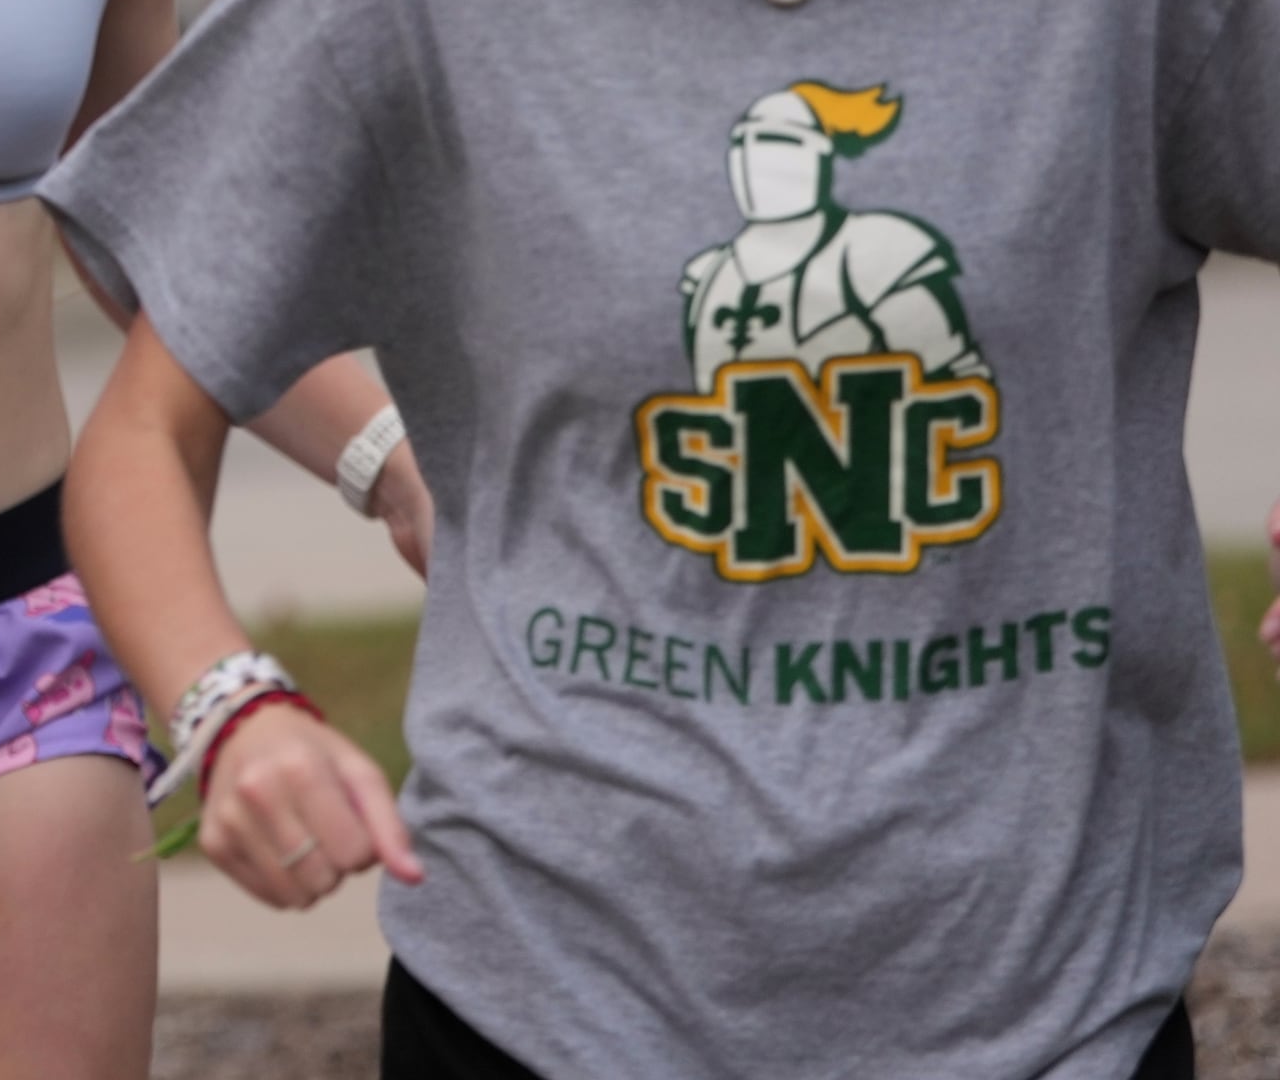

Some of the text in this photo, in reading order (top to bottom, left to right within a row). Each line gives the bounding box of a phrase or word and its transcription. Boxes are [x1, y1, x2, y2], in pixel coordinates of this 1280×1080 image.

[636, 353, 1001, 581] SNC
[525, 606, 1113, 706] GREEN KNIGHTS
